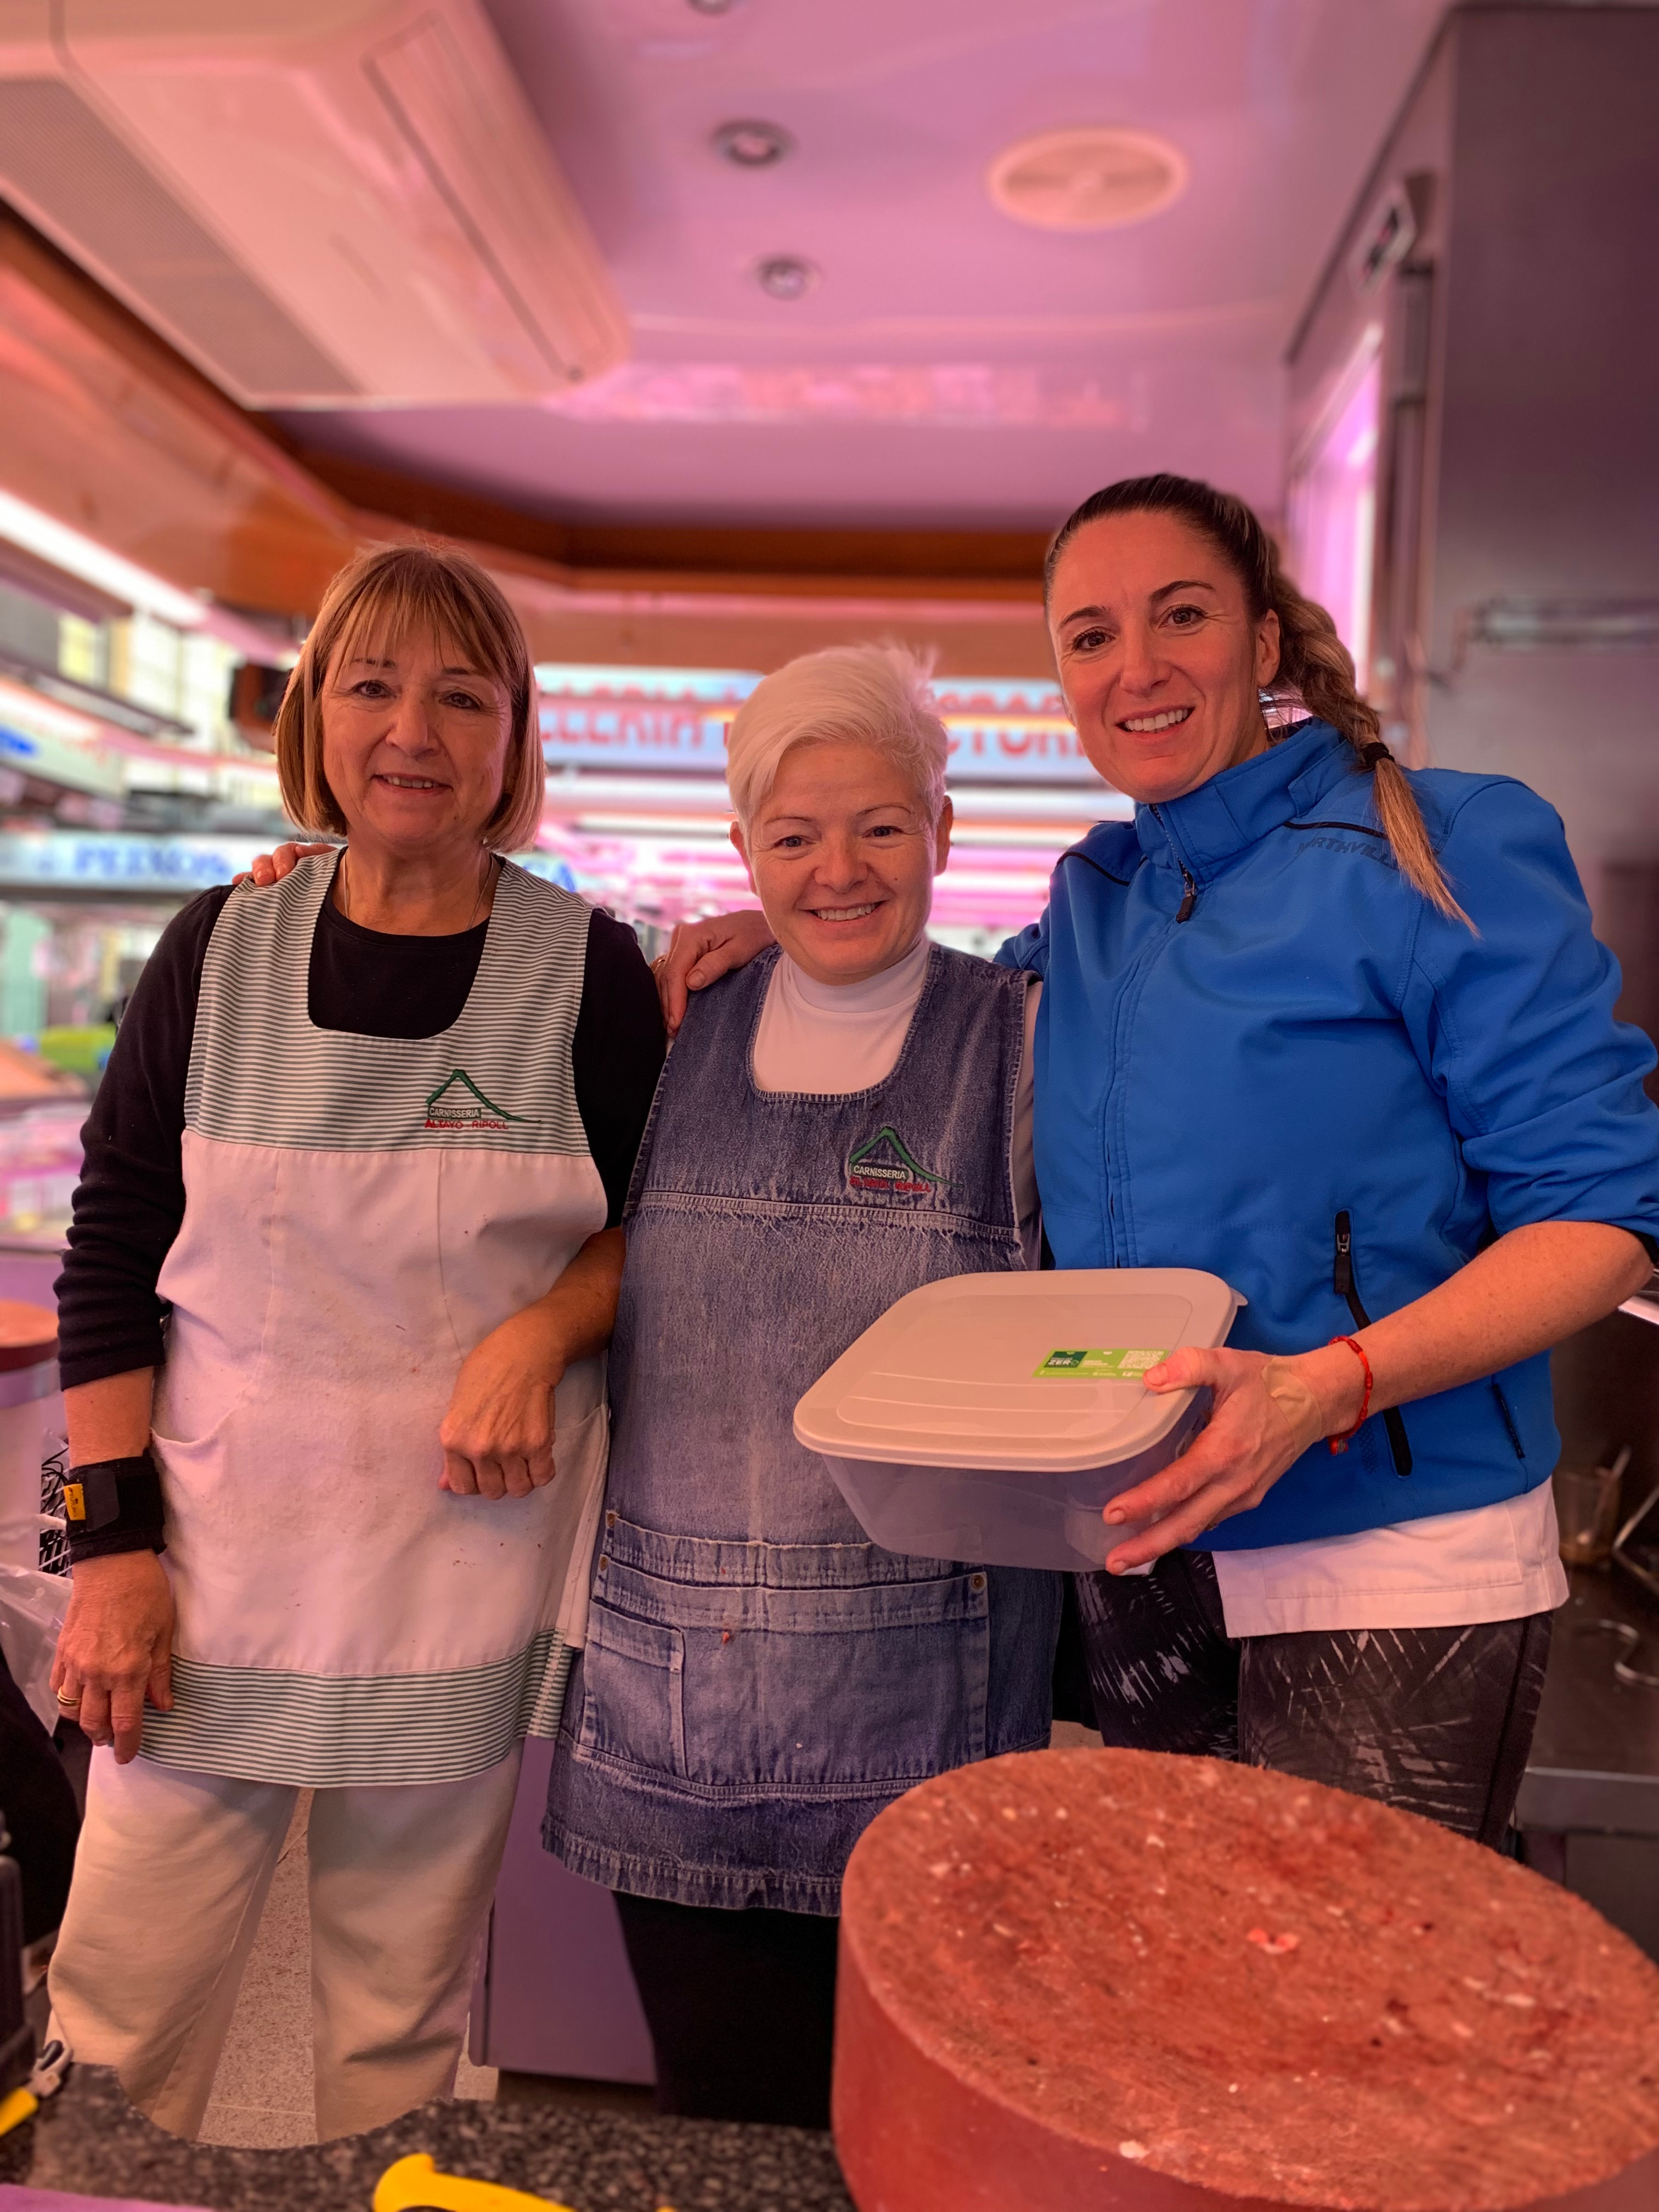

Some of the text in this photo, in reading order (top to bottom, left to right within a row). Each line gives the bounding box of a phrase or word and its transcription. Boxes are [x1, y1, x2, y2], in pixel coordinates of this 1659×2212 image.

[430, 1108, 479, 1118] CARNISSERIA
[472, 1120, 509, 1130] RIPOLL
[854, 1165, 906, 1179] CARNISSERIA
